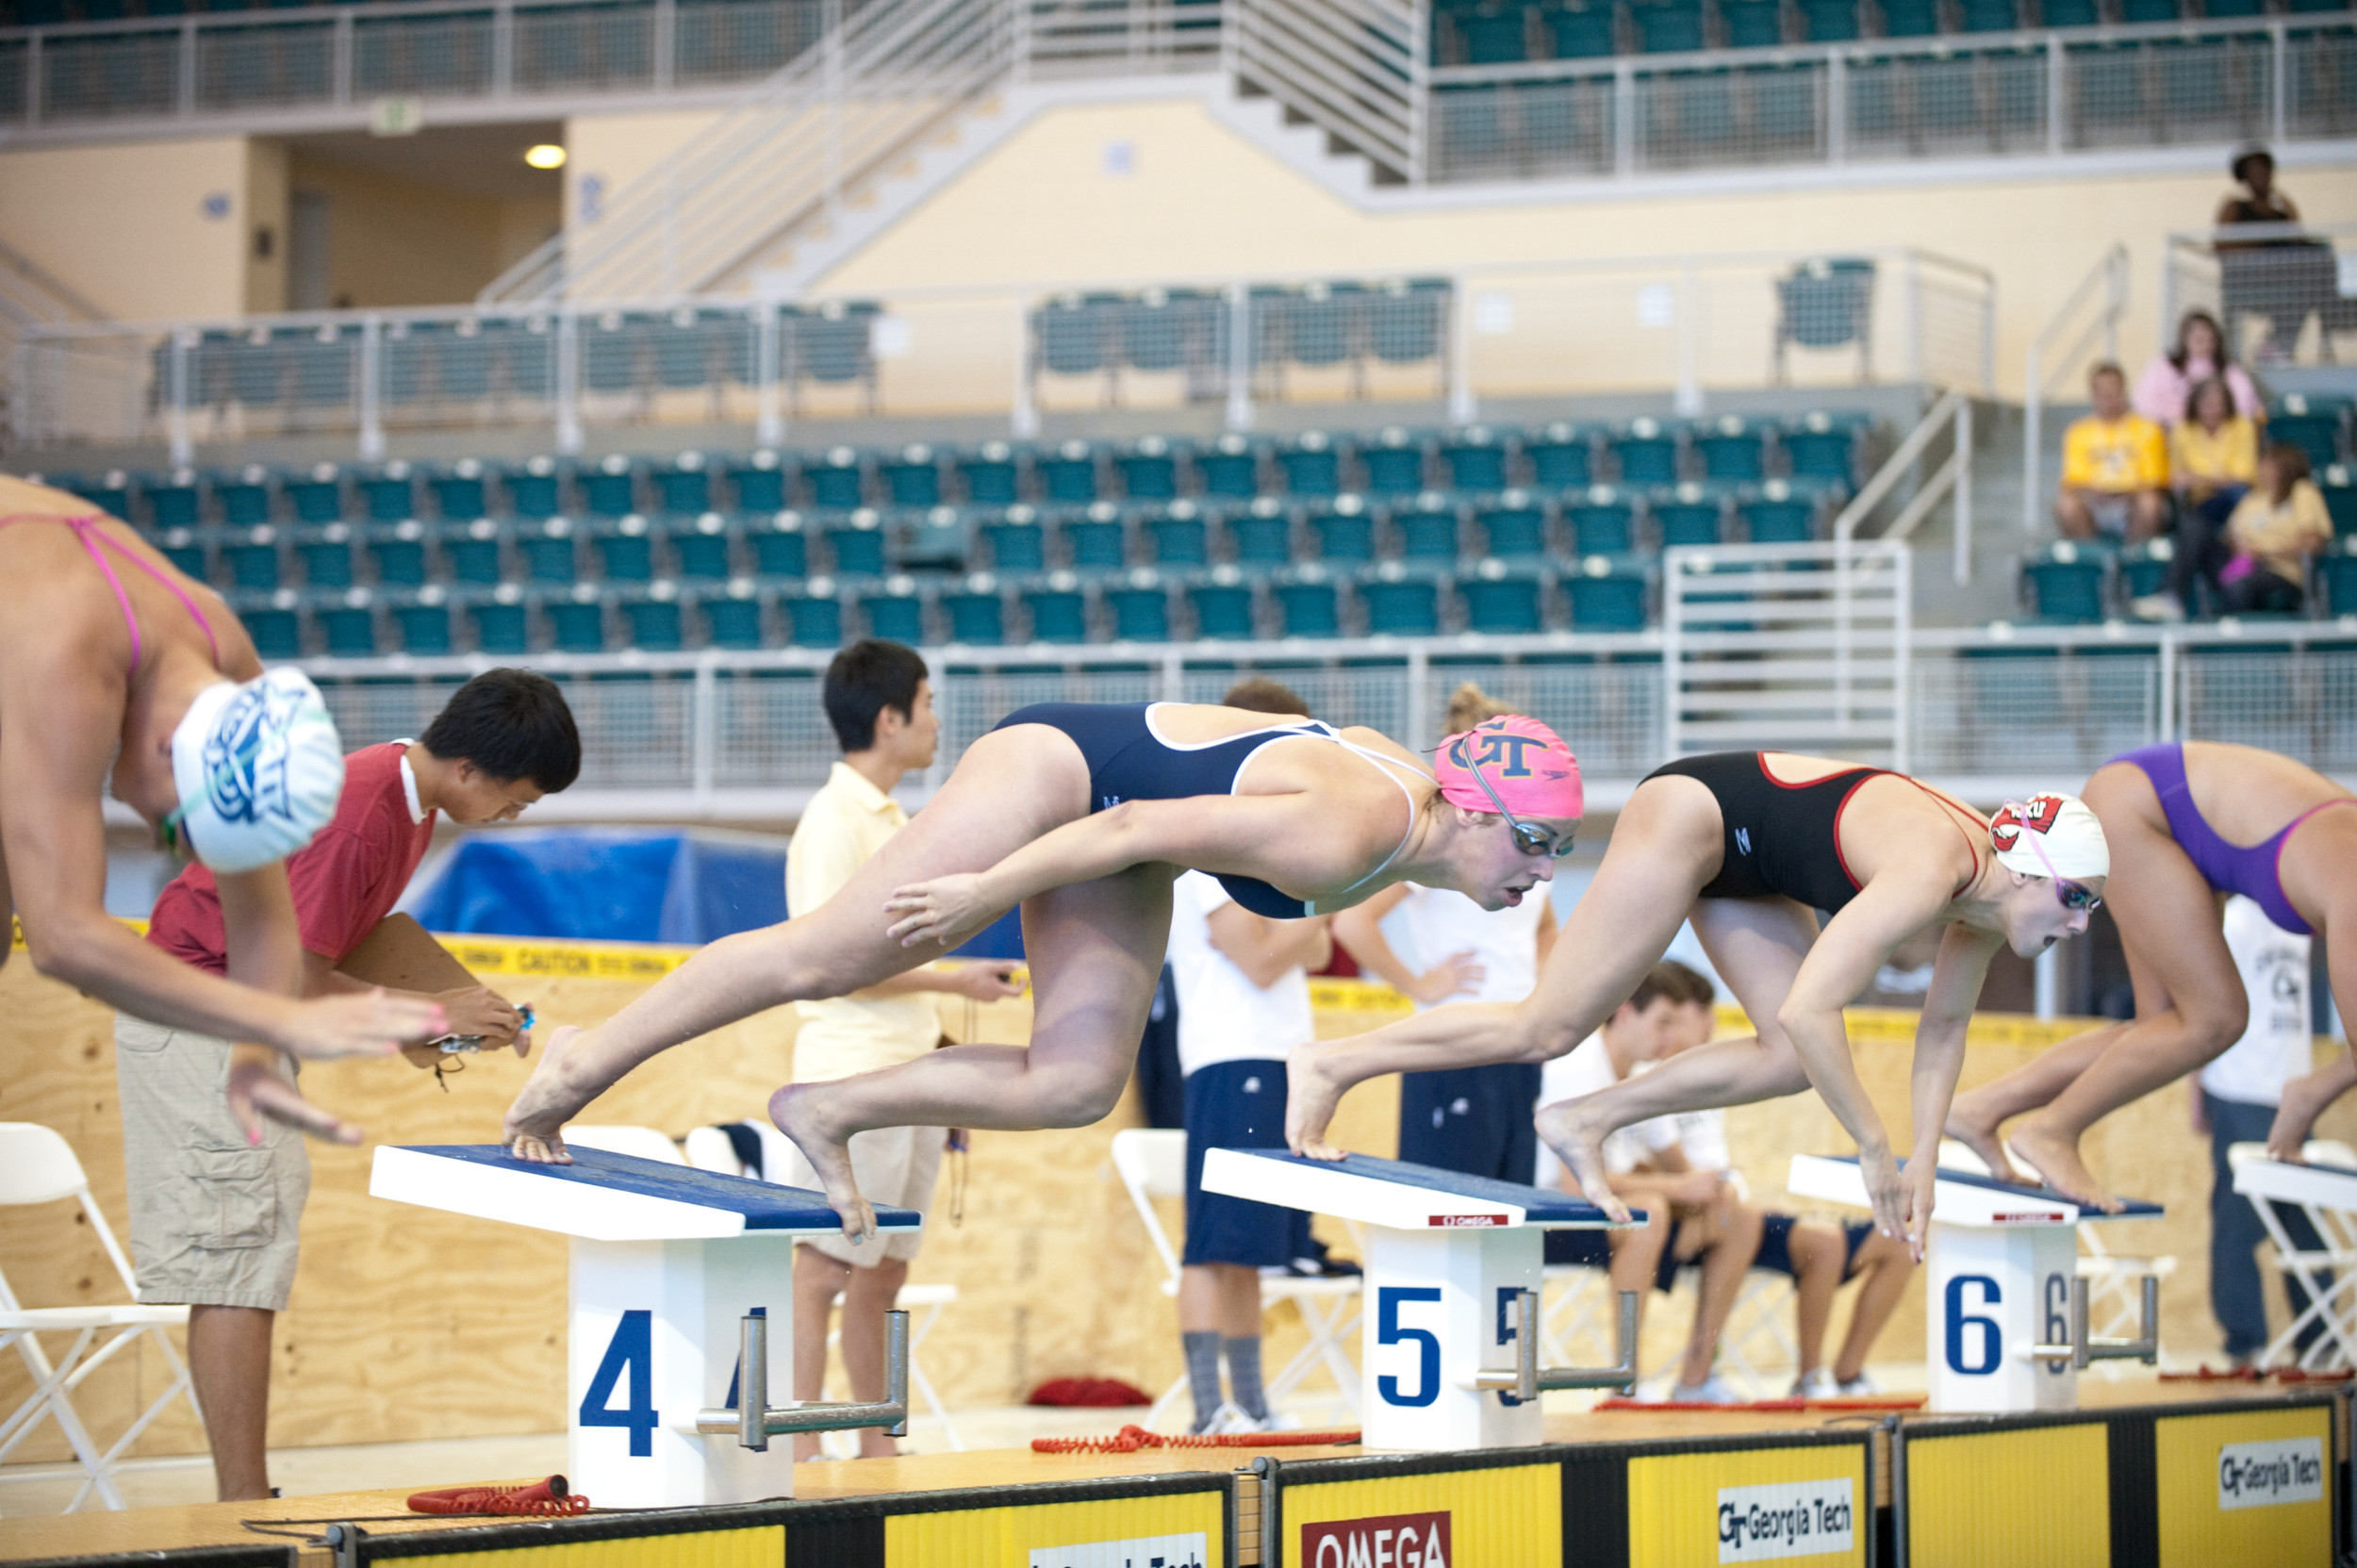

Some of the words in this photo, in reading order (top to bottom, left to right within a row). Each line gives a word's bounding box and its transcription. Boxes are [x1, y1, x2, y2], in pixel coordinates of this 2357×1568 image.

[1449, 720, 1548, 777] GT
[1377, 1287, 1442, 1408] 5
[1945, 1275, 2002, 1376] 6
[2045, 1274, 2068, 1376] 6
[579, 1310, 659, 1458] 4
[1315, 1521, 1448, 1568] OMEGA
[1749, 1497, 1809, 1547] Georgia
[1814, 1493, 1851, 1534] Tech
